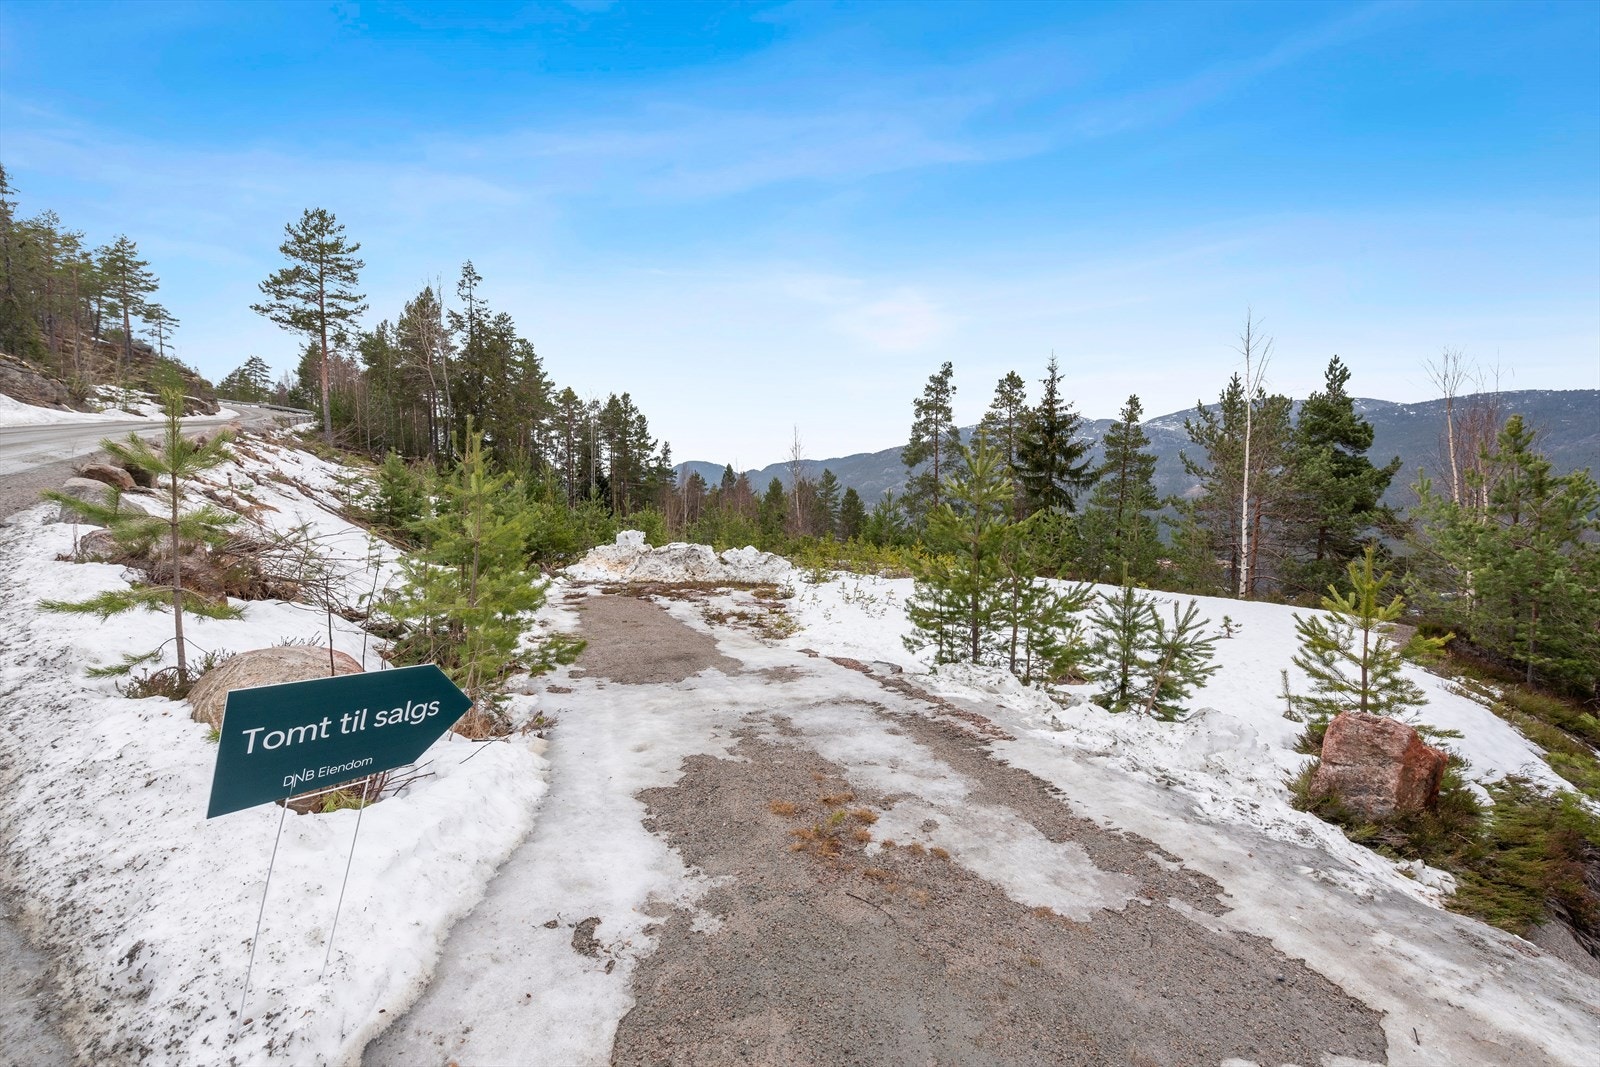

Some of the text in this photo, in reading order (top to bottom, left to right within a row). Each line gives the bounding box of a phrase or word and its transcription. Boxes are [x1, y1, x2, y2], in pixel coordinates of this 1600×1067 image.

[242, 700, 441, 754] Tomt til salgs
[282, 757, 374, 788] DNB Eiendom
